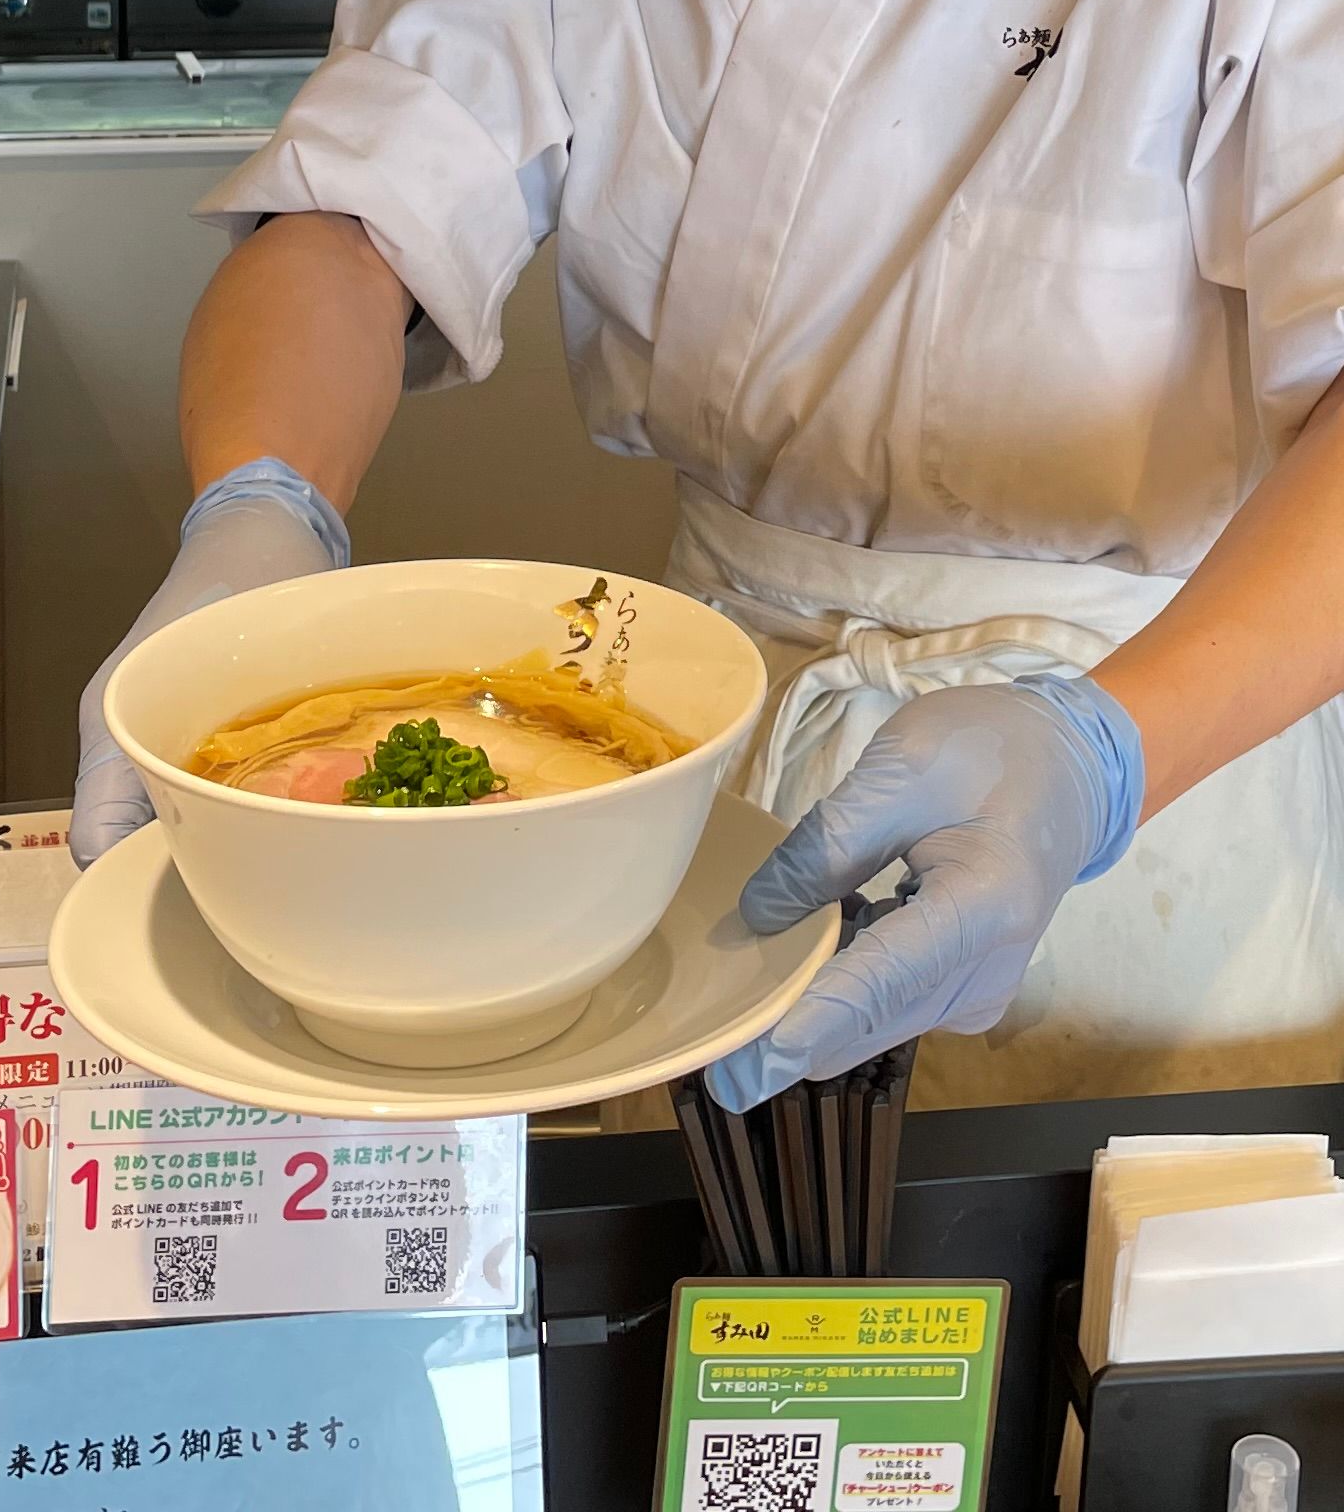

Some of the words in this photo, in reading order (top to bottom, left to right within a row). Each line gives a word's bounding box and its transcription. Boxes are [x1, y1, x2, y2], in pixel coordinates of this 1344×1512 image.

[1002, 27, 1051, 48] らぁ麺
[91, 1110, 153, 1130] LINE
[114, 1150, 257, 1171] 初めてのお客様は
[283, 1151, 329, 1220] 2
[332, 1178, 451, 1192] 公式ポイントカード内の
[71, 1159, 99, 1230] 1
[332, 1191, 450, 1206] チェックインボタンより
[112, 1203, 133, 1216] 公式
[137, 1201, 163, 1214] LINE
[166, 1199, 244, 1213] の友だち追加で
[331, 1207, 348, 1219] QR
[860, 1307, 970, 1324] 公式LINE
